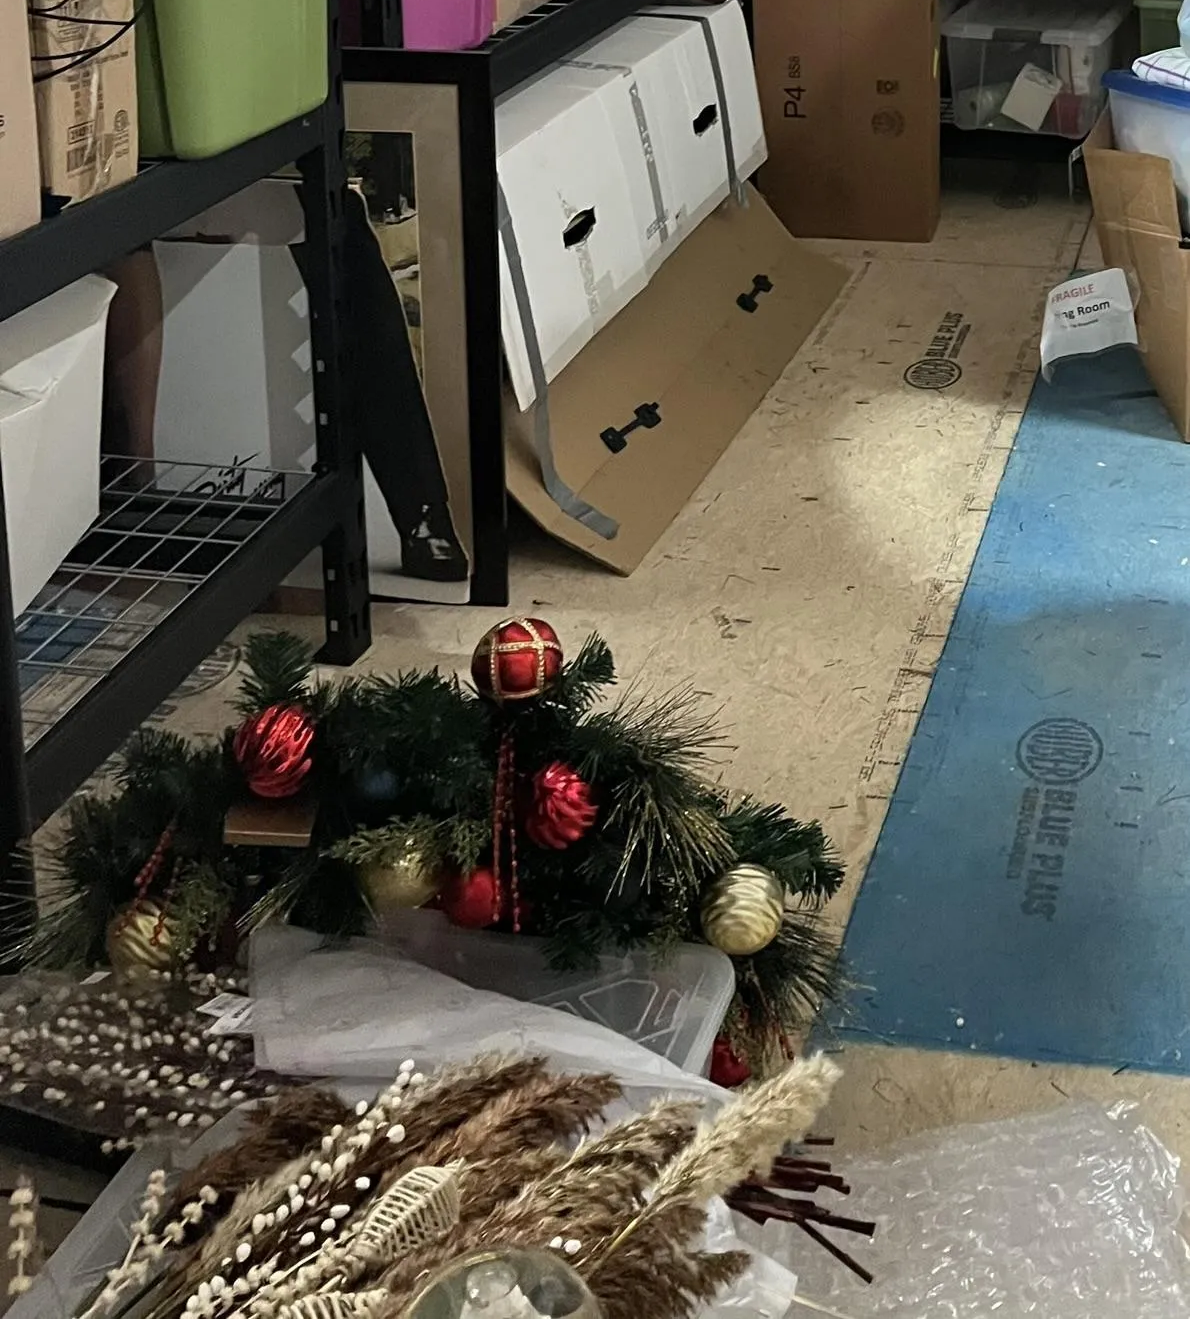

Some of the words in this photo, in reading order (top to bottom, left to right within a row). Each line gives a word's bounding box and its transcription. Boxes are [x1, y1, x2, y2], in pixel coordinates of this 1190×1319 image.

[783, 85, 807, 119] P4
[1077, 300, 1111, 316] Room
[937, 311, 964, 334] PLUS
[925, 335, 953, 358] BLUE
[1036, 788, 1078, 847] BLUE
[1020, 854, 1065, 921] PLUS
